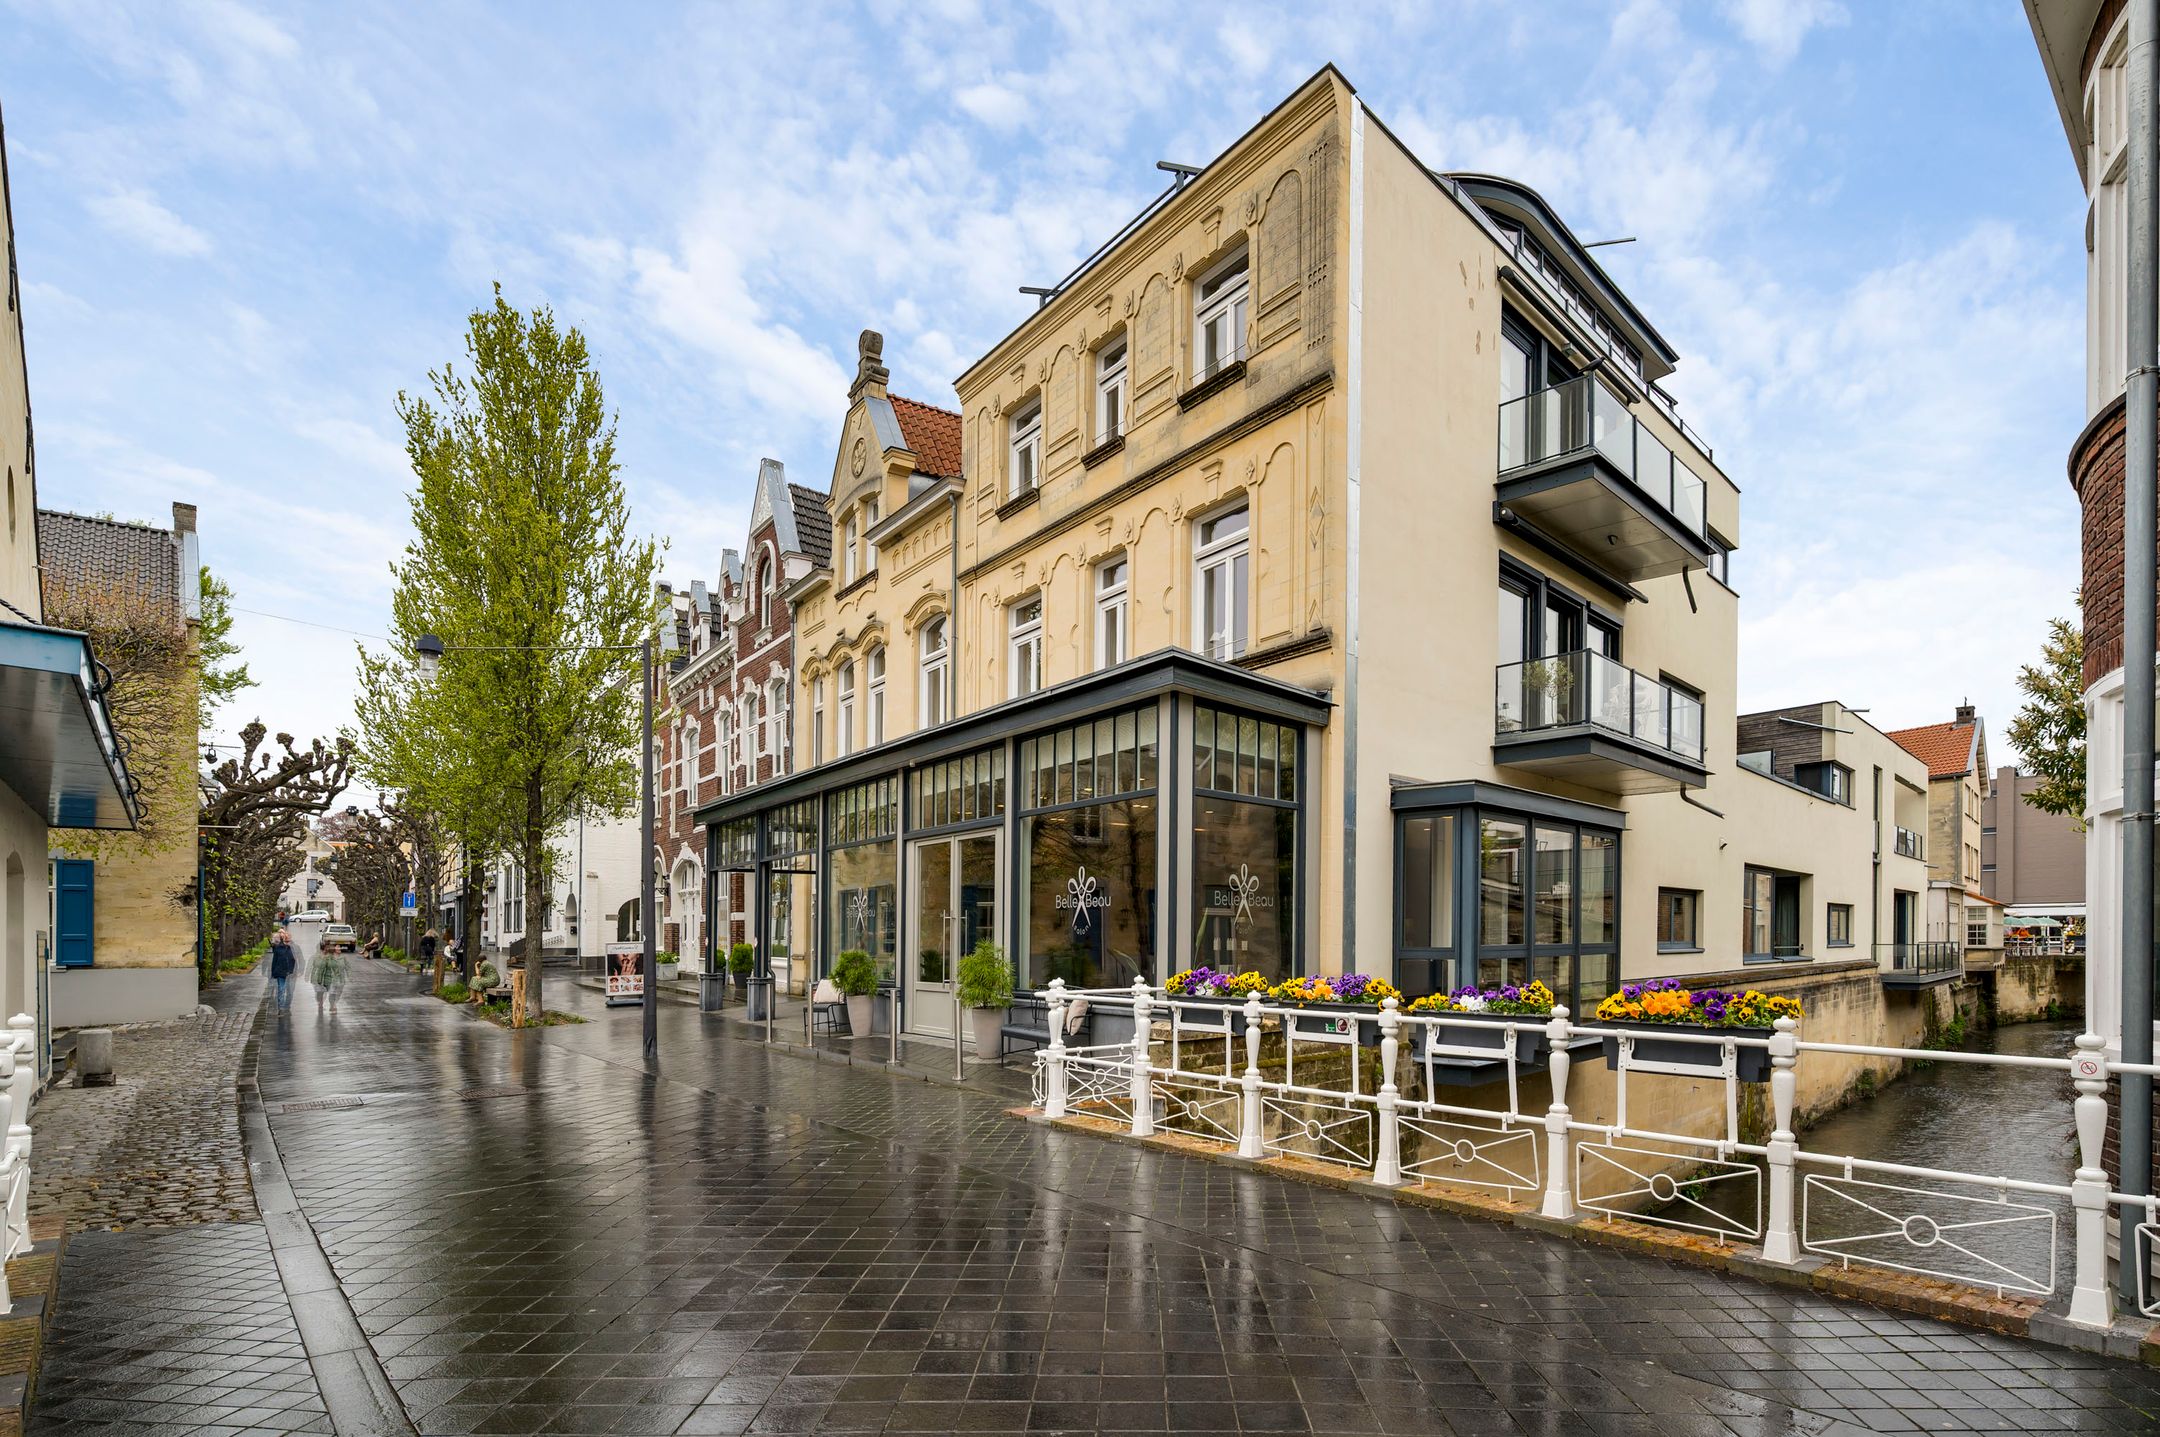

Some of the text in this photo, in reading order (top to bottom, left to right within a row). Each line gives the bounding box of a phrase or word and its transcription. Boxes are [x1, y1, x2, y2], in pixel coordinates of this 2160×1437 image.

[1055, 893, 1112, 909] Belle Beau
[1214, 890, 1274, 907] Belle Beau
